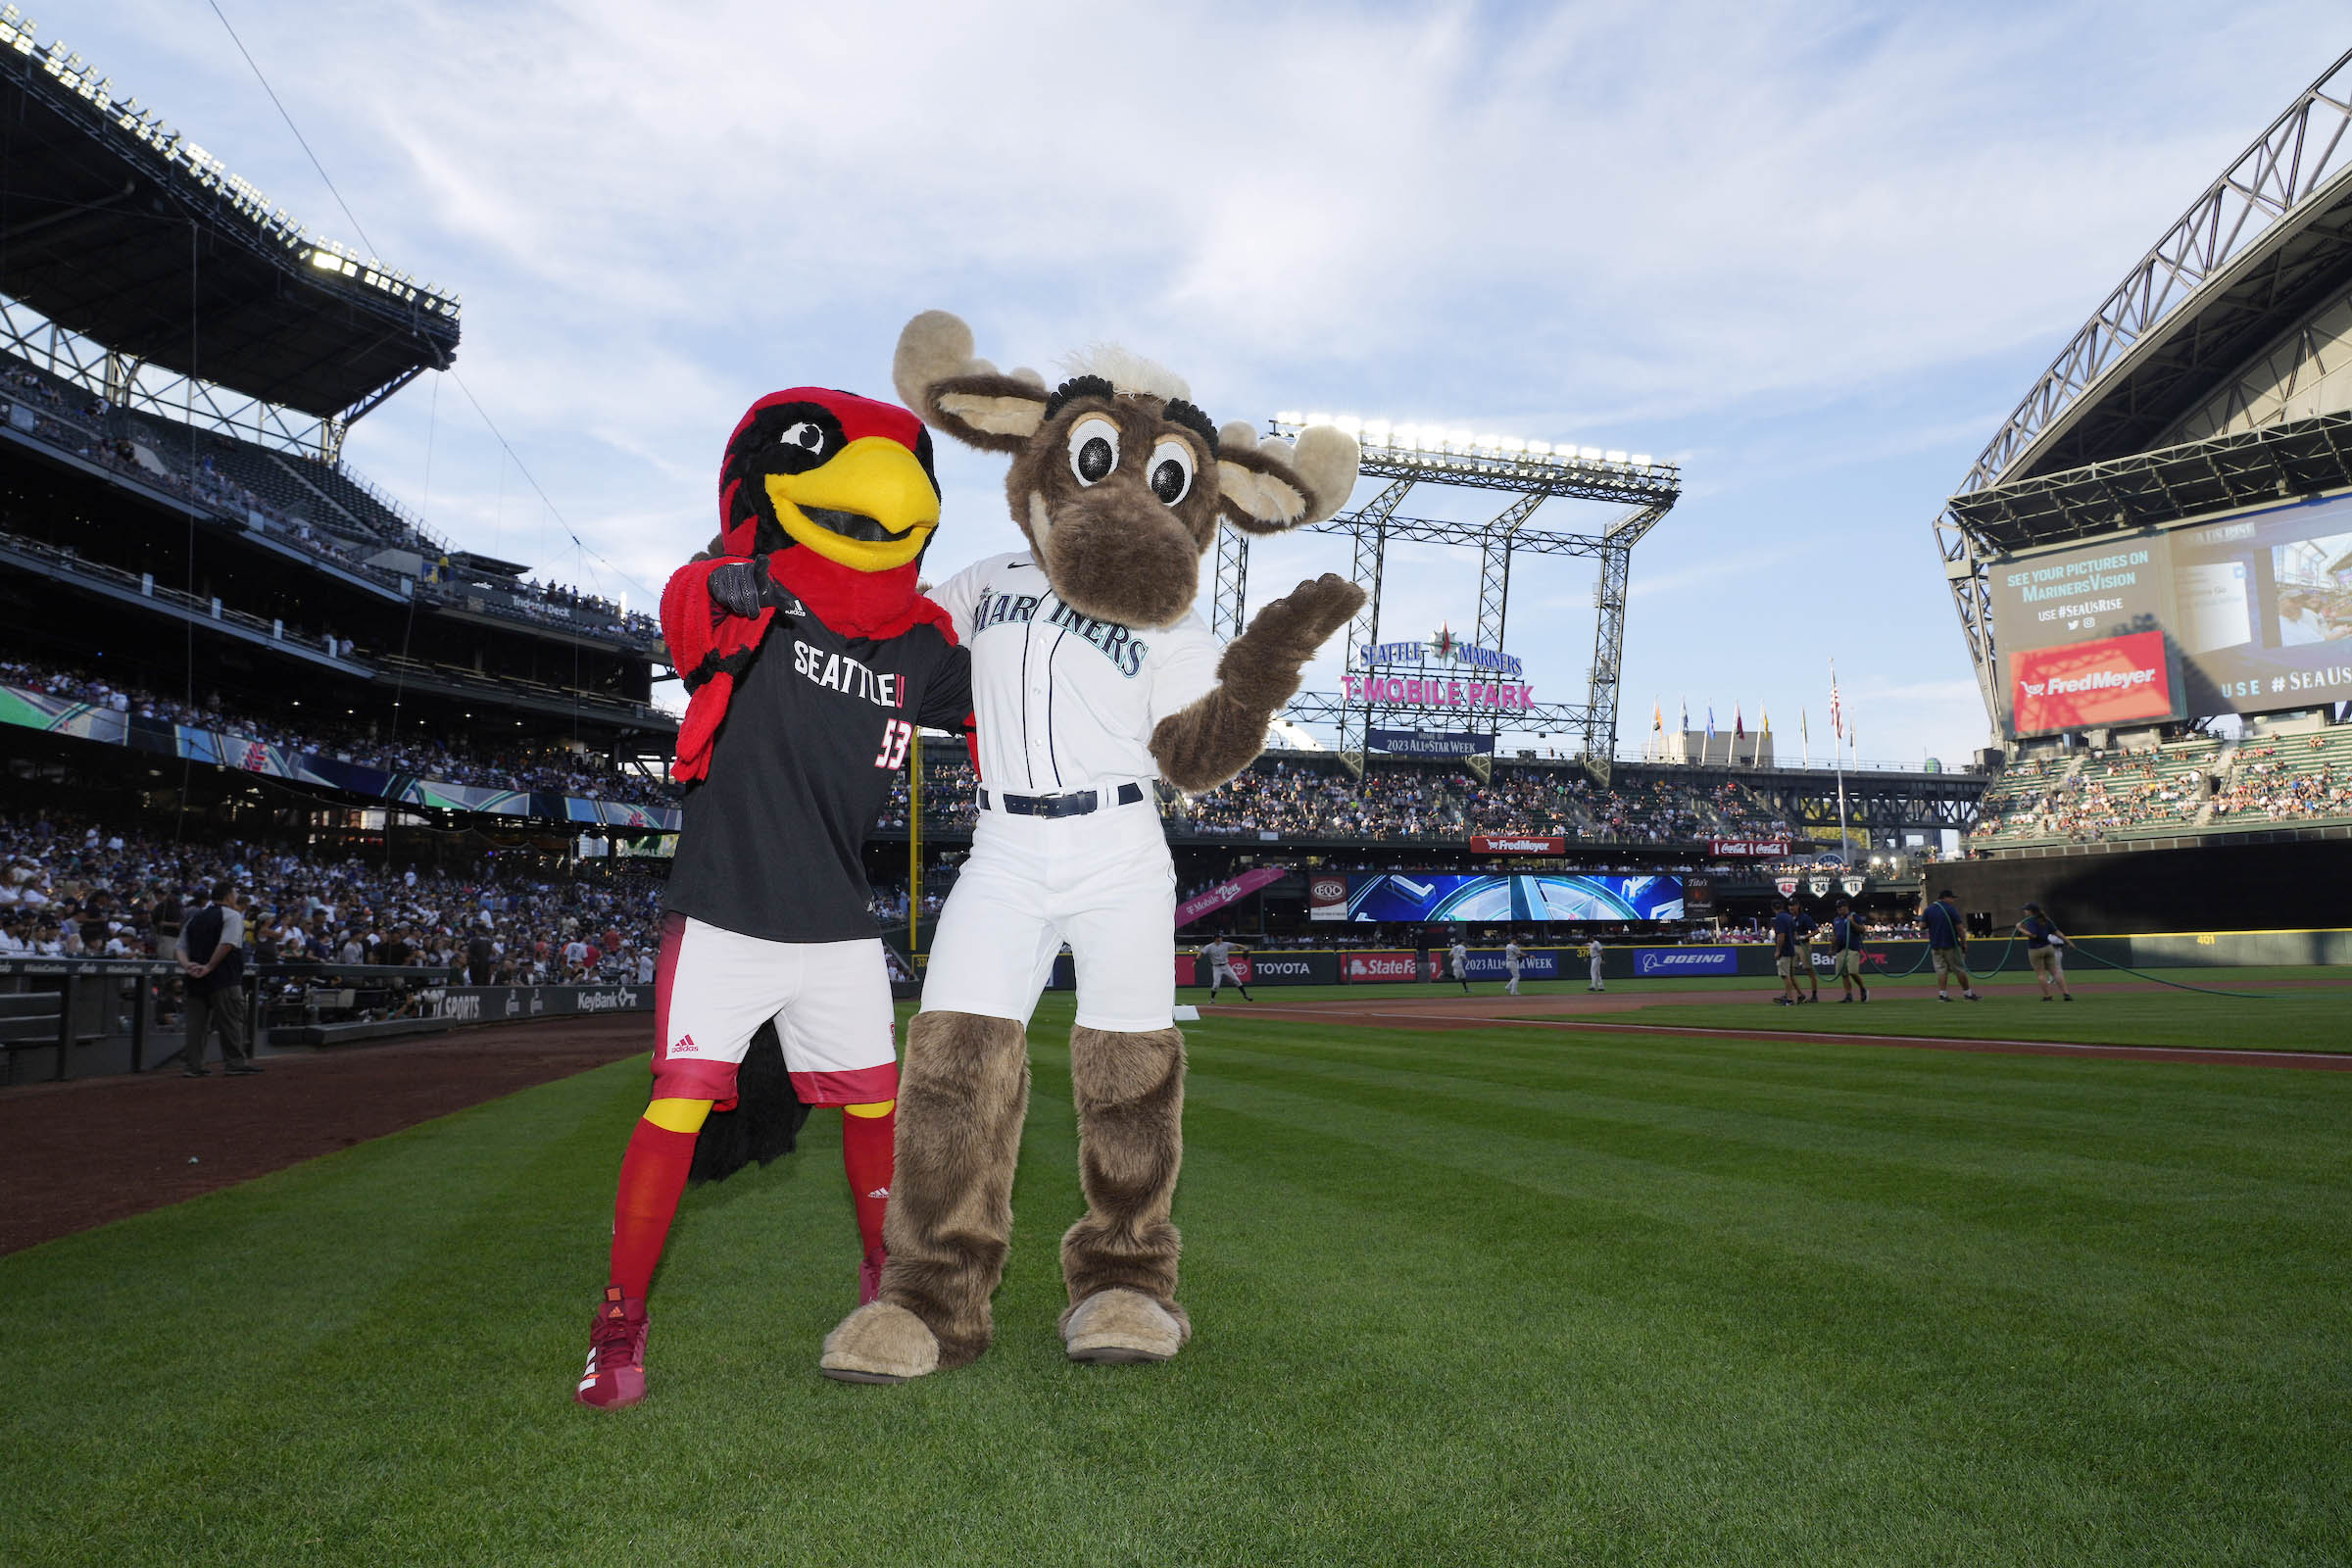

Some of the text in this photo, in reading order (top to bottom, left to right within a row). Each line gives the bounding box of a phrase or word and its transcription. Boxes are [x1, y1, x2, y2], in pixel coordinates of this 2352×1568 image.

[2007, 551, 2149, 587] SEE YOUR PICTURES ON
[547, 604, 570, 617] Deck
[2038, 610, 2057, 621] USE
[971, 594, 1150, 678] MARINERS
[1359, 642, 1523, 676] SEATTLE MARINERS
[1340, 675, 1536, 710] T-MOBILE PARK
[2221, 680, 2261, 698] USE
[875, 718, 913, 770] 53
[1387, 740, 1409, 751] 2023
[1450, 742, 1476, 753] WEEK
[1781, 884, 1793, 894] 42
[1815, 883, 1827, 893] 24
[1849, 883, 1858, 892] 11
[2197, 935, 2216, 945] 401
[1465, 959, 1486, 970] 2023
[1526, 957, 1552, 969] WEEK
[1663, 955, 1726, 964] BOEING
[1255, 962, 1310, 974] TOYOTA
[577, 991, 617, 1011] KeyBank
[446, 996, 479, 1020] SPORTS
